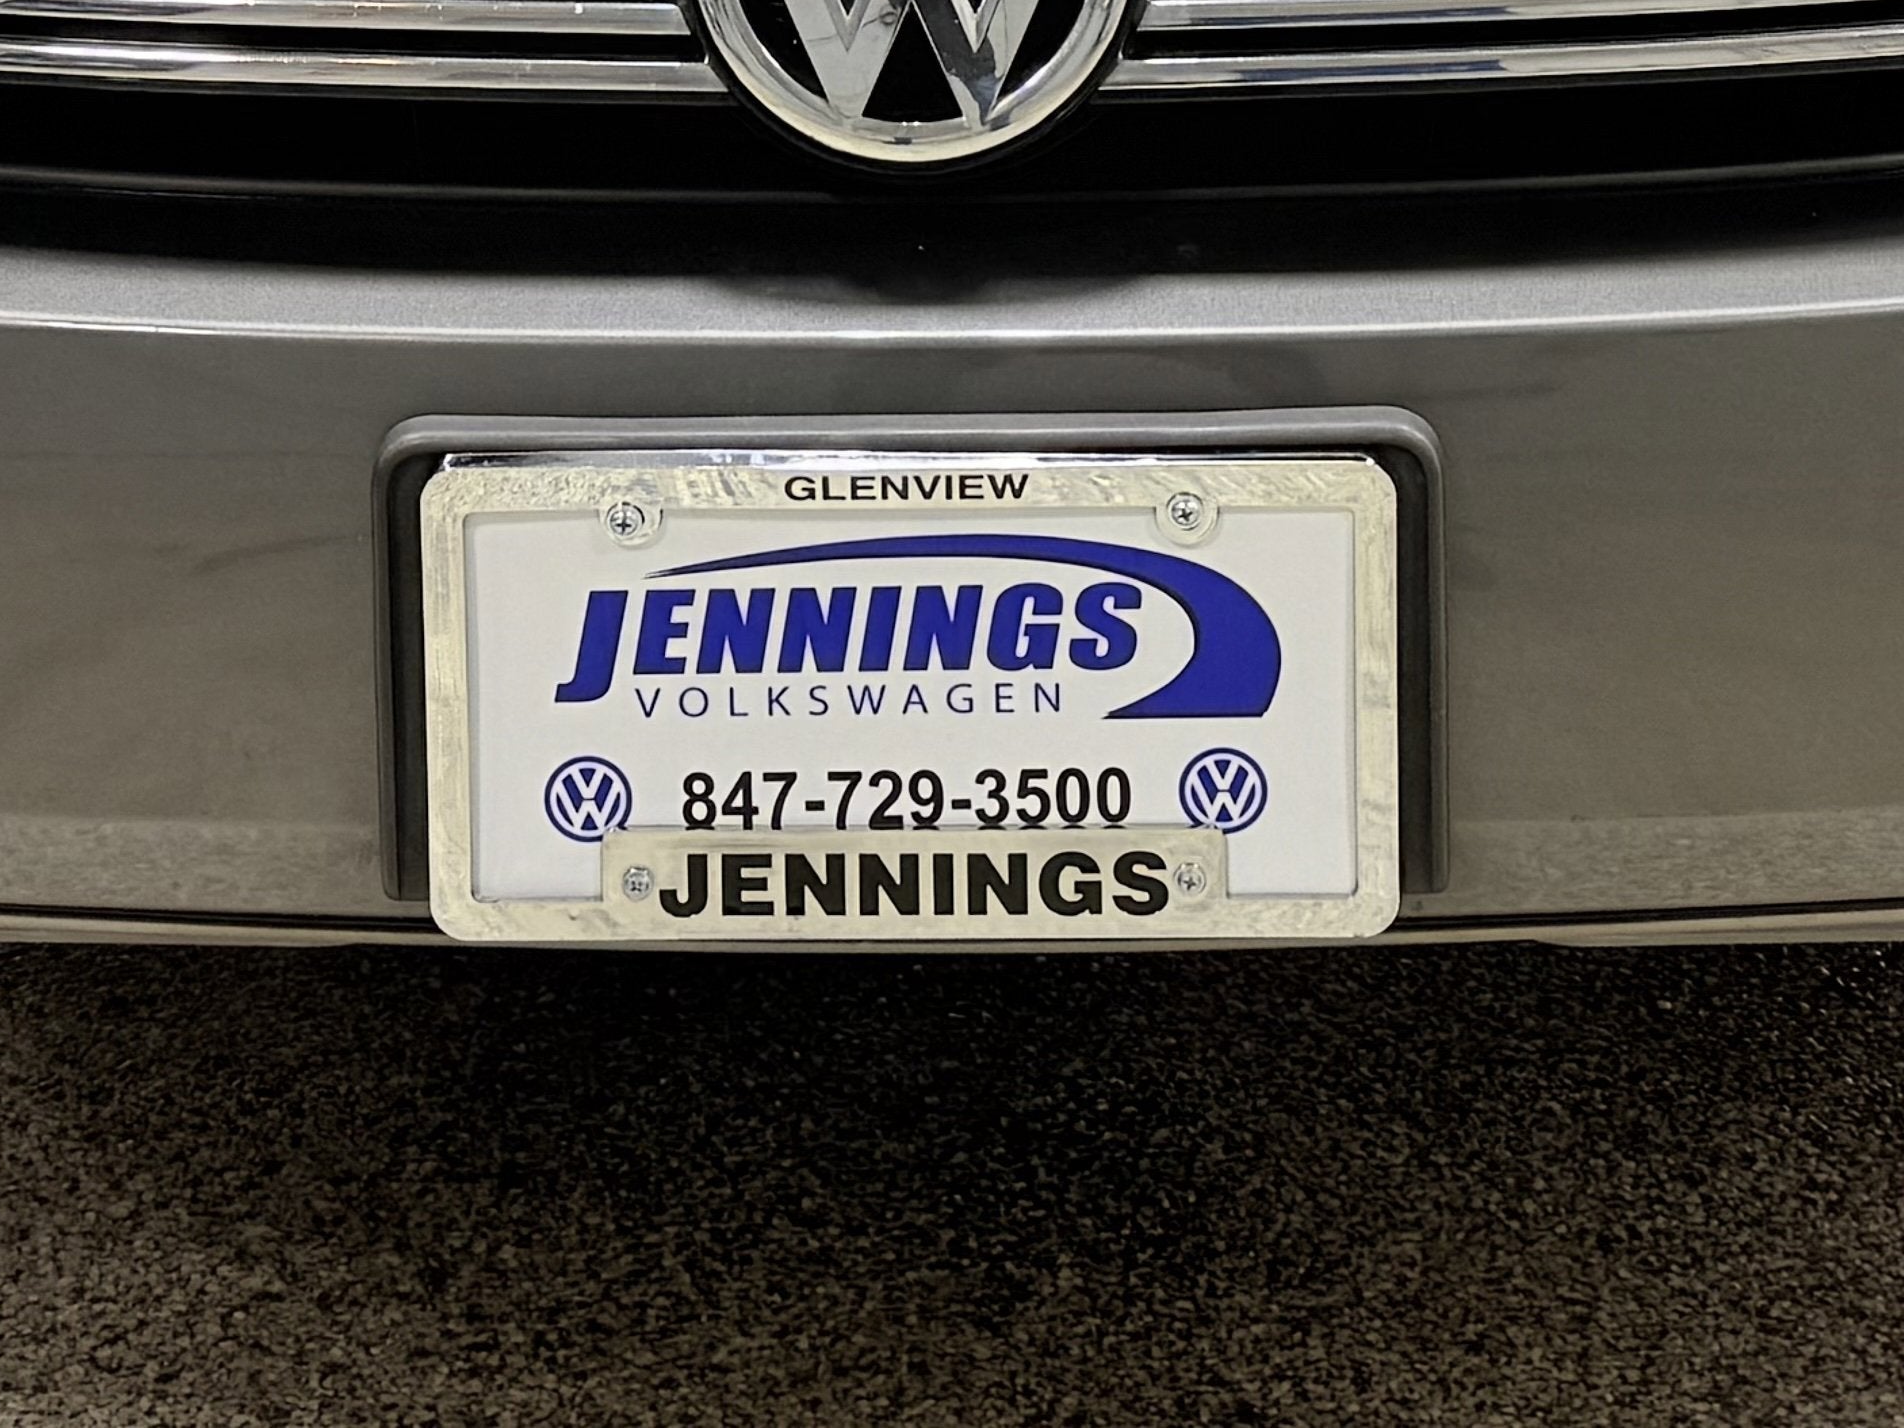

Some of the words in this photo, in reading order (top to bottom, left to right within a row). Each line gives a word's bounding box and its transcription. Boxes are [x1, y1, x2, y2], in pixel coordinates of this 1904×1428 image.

[783, 473, 1030, 503] GLENVIEW
[554, 581, 1143, 704] JENNINGS
[633, 680, 1063, 719] VOLKSWAGEN
[680, 765, 1134, 831] 847-729-3500
[658, 849, 1172, 918] JENNINGS
